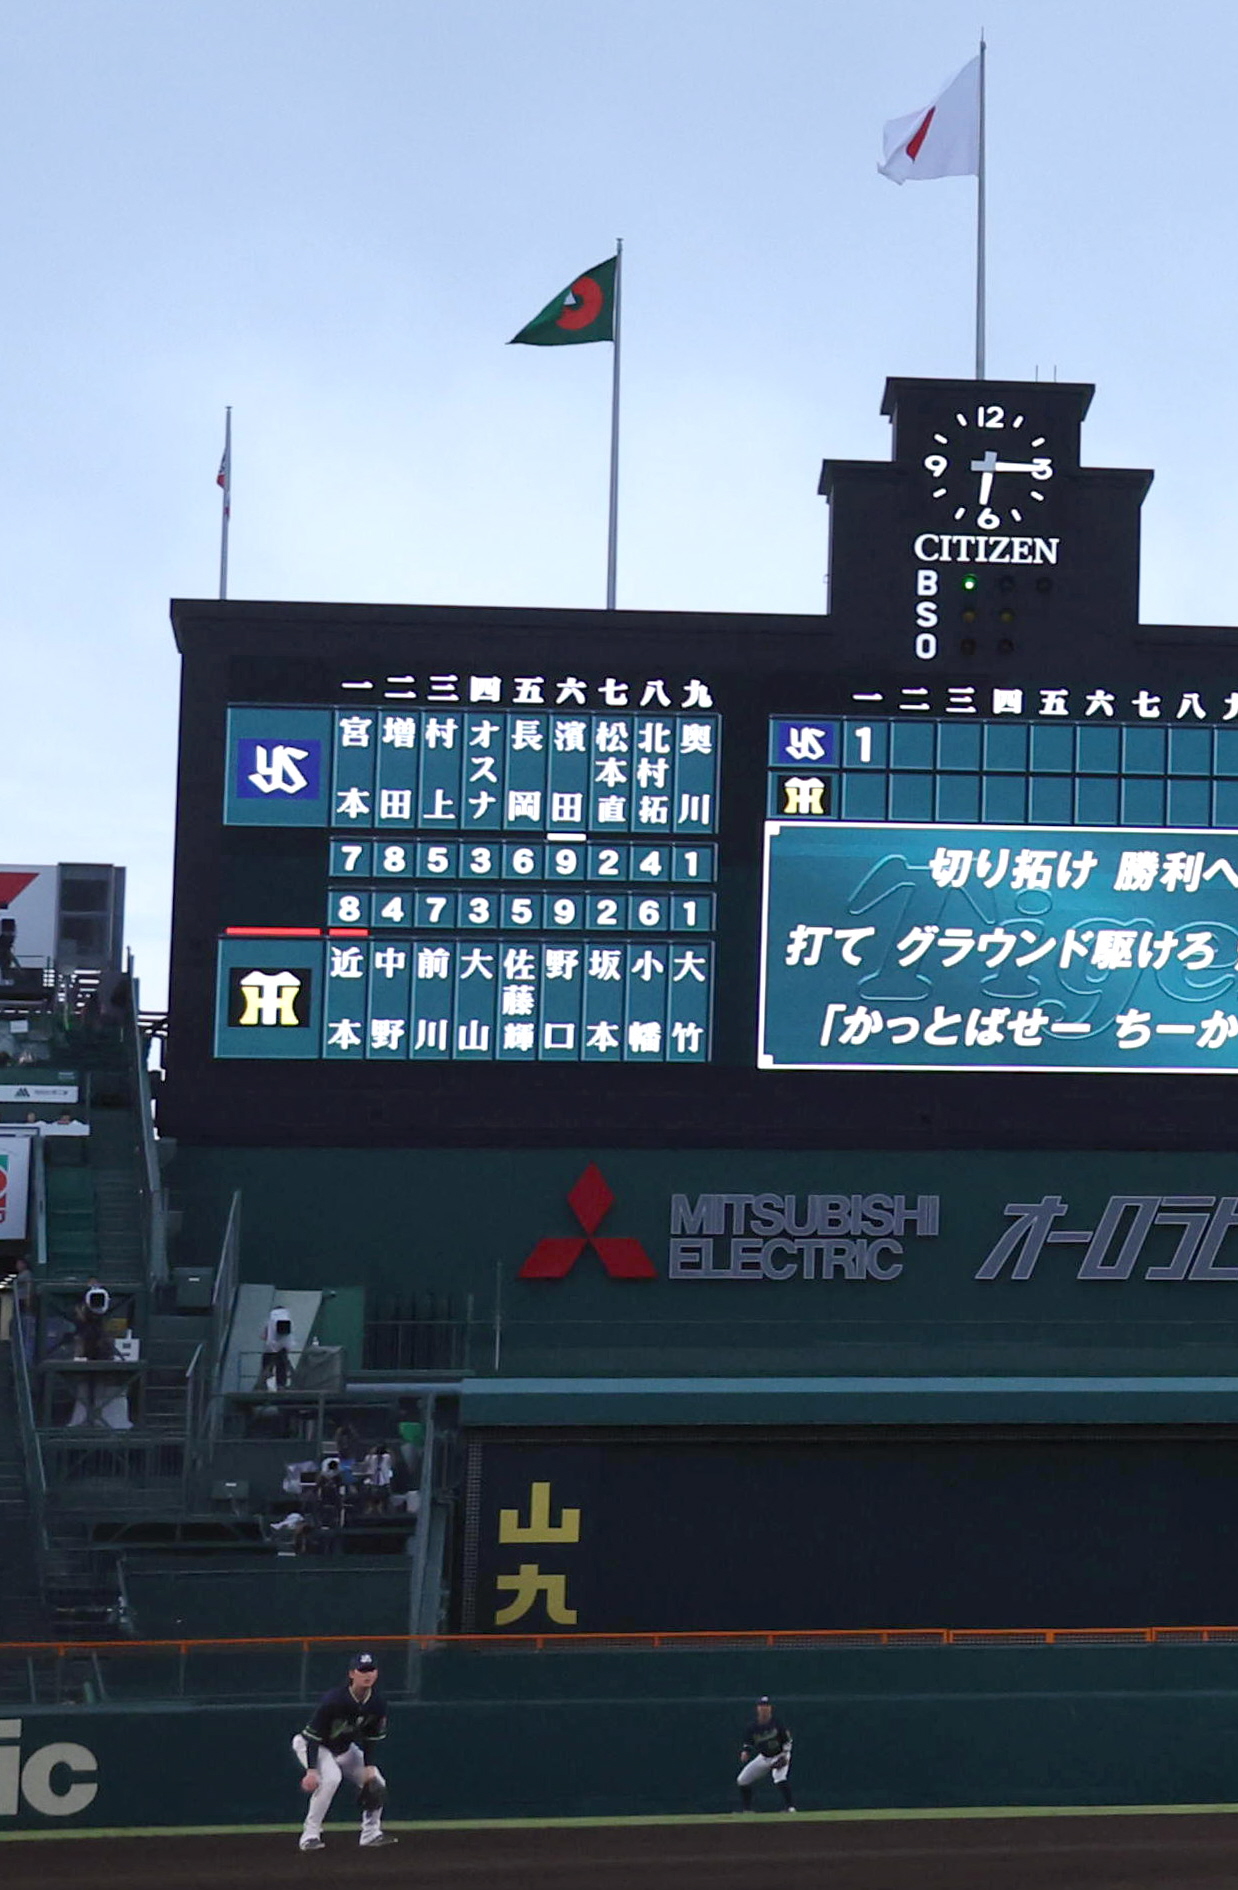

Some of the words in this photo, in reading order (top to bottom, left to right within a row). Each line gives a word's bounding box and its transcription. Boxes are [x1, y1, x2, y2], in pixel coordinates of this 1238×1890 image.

[978, 407, 1003, 427] 12
[925, 456, 947, 477] 9
[1032, 458, 1053, 480] 3
[915, 534, 1059, 563] CITIZEN
[978, 508, 999, 529] 6
[917, 602, 937, 627] S
[918, 570, 937, 595] B
[385, 676, 416, 698] 二
[428, 675, 458, 700] 三
[470, 676, 501, 701] 四
[513, 677, 544, 703] 五
[557, 678, 586, 704] 六
[598, 679, 628, 705] 七
[640, 680, 670, 706] 八
[682, 680, 712, 707] 九
[900, 688, 929, 709] 二
[946, 687, 976, 712] 三
[994, 689, 1022, 713] 四
[1039, 690, 1068, 715] 五
[1086, 690, 1114, 716] 六
[1132, 691, 1160, 717] 七
[1177, 693, 1205, 718] 八
[337, 717, 372, 818] 宮本
[381, 717, 415, 819] 増田
[424, 718, 458, 818] 村上
[469, 720, 499, 818] オスナ
[508, 720, 542, 821] 長岡
[552, 721, 586, 822] 濱田
[596, 722, 628, 822] 松本直
[637, 723, 670, 823] 北村拓
[679, 724, 711, 824] 奥川
[856, 727, 871, 762] 1
[342, 846, 362, 871] 7
[384, 846, 405, 872] 8
[428, 847, 448, 872] 5
[471, 848, 491, 873] 3
[513, 848, 533, 874] 6
[556, 849, 576, 874] 9
[599, 850, 618, 874] 2
[640, 851, 661, 875] 4
[685, 852, 697, 876] 1
[930, 848, 1097, 889] 切り拓け
[339, 896, 360, 921] 8
[382, 897, 404, 921] 4
[426, 898, 446, 922] 7
[469, 898, 489, 923] 3
[512, 899, 532, 924] 5
[554, 899, 575, 924] 9
[597, 900, 617, 924] 2
[639, 900, 659, 925] 6
[684, 901, 695, 925] 1
[786, 925, 874, 965] 打て
[898, 926, 1213, 969] グラウンド駆けろ
[328, 947, 363, 1049] 近本
[371, 948, 405, 1049] 中野
[415, 948, 450, 1050] 前川
[459, 948, 493, 1050] 大山
[545, 950, 578, 1049] 野口
[587, 950, 621, 1052] 坂本
[672, 951, 705, 1052] 大竹
[821, 1005, 1090, 1045] 「かっとばせー
[671, 1194, 939, 1236] MITSUBISHI
[669, 1238, 903, 1280] ELECTRIC
[497, 1483, 579, 1623] 山九
